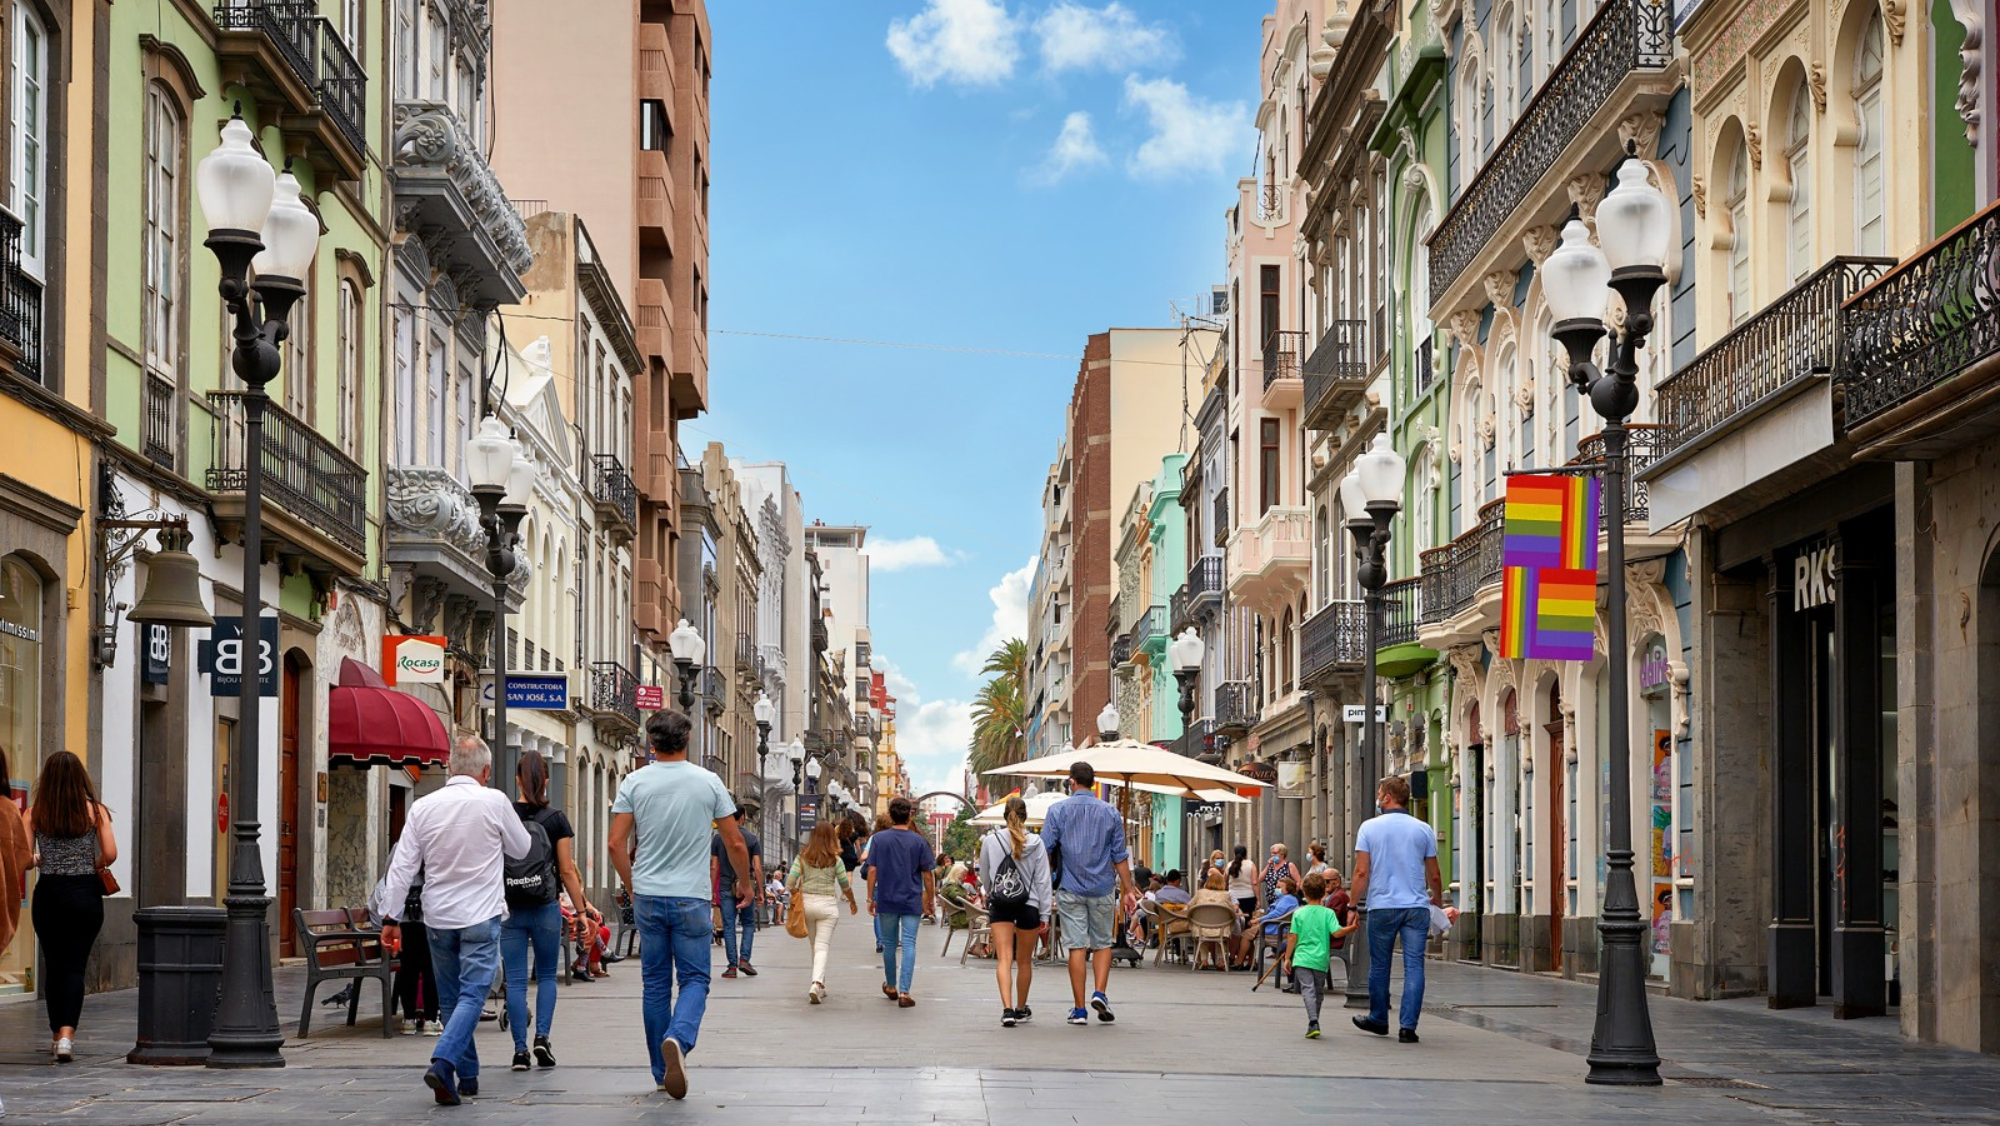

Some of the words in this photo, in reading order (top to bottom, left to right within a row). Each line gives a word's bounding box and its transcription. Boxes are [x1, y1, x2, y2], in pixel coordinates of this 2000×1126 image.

[397, 655, 440, 671] Rocasa
[507, 682, 563, 690] CONSTRUCTORA
[525, 692, 547, 702] JOSÉ,
[549, 694, 564, 702] S.A.
[506, 874, 542, 887] Reebok
